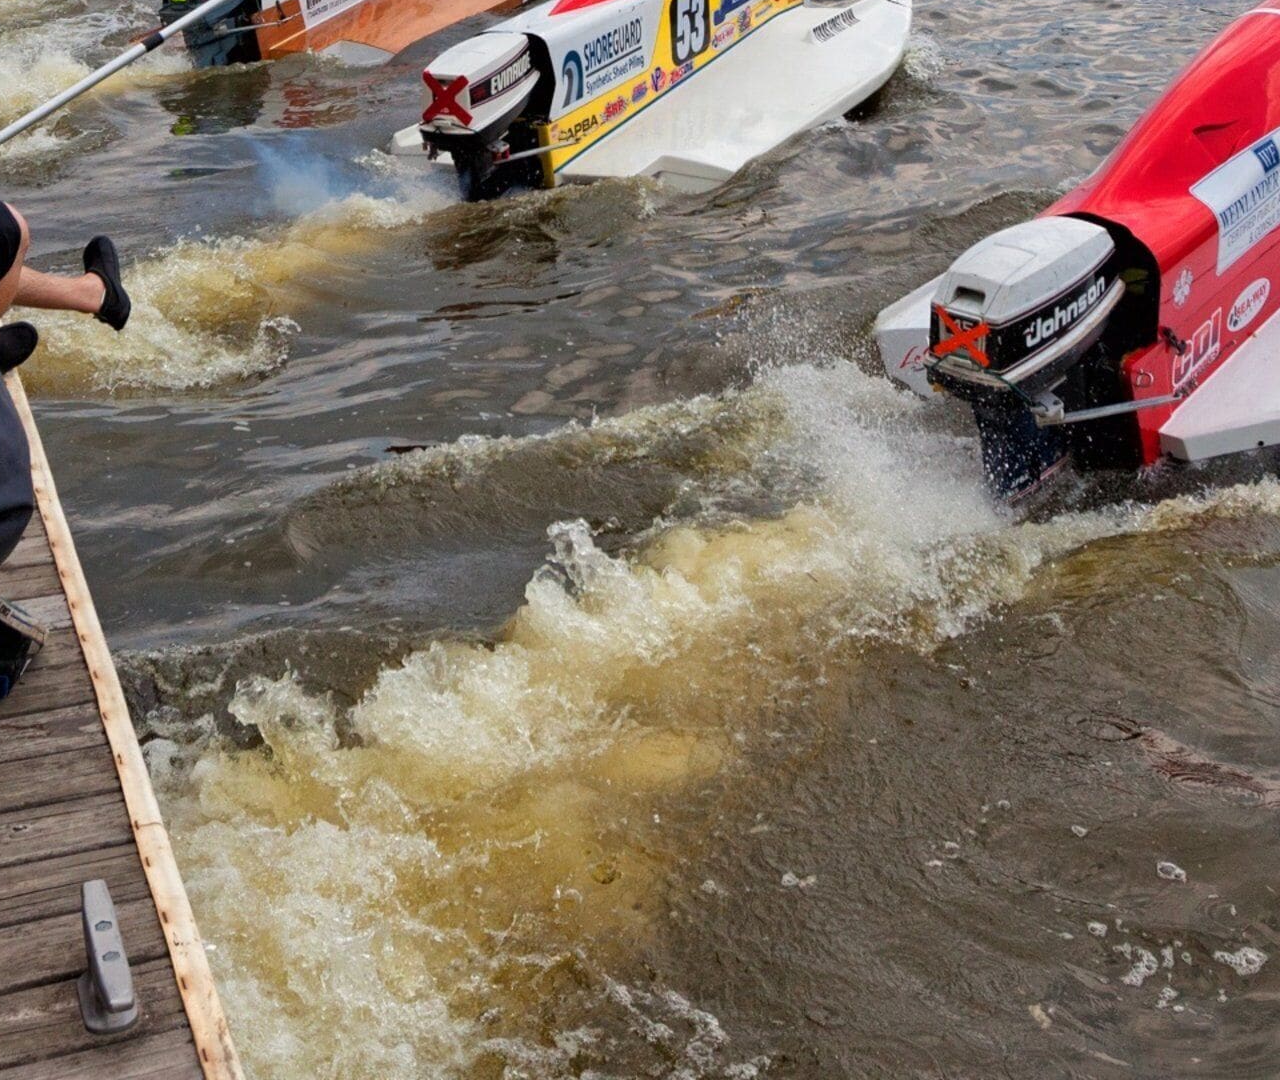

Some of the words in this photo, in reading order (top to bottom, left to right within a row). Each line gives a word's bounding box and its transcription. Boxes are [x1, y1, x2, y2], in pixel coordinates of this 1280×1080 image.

[584, 18, 642, 71] SHOREGUARD
[490, 50, 531, 96] EVINRUDE
[586, 70, 612, 96] Synthetic
[612, 63, 629, 80] Sheet
[567, 115, 599, 139] APBA
[1258, 143, 1279, 167] WF
[1024, 276, 1106, 347] Johnson
